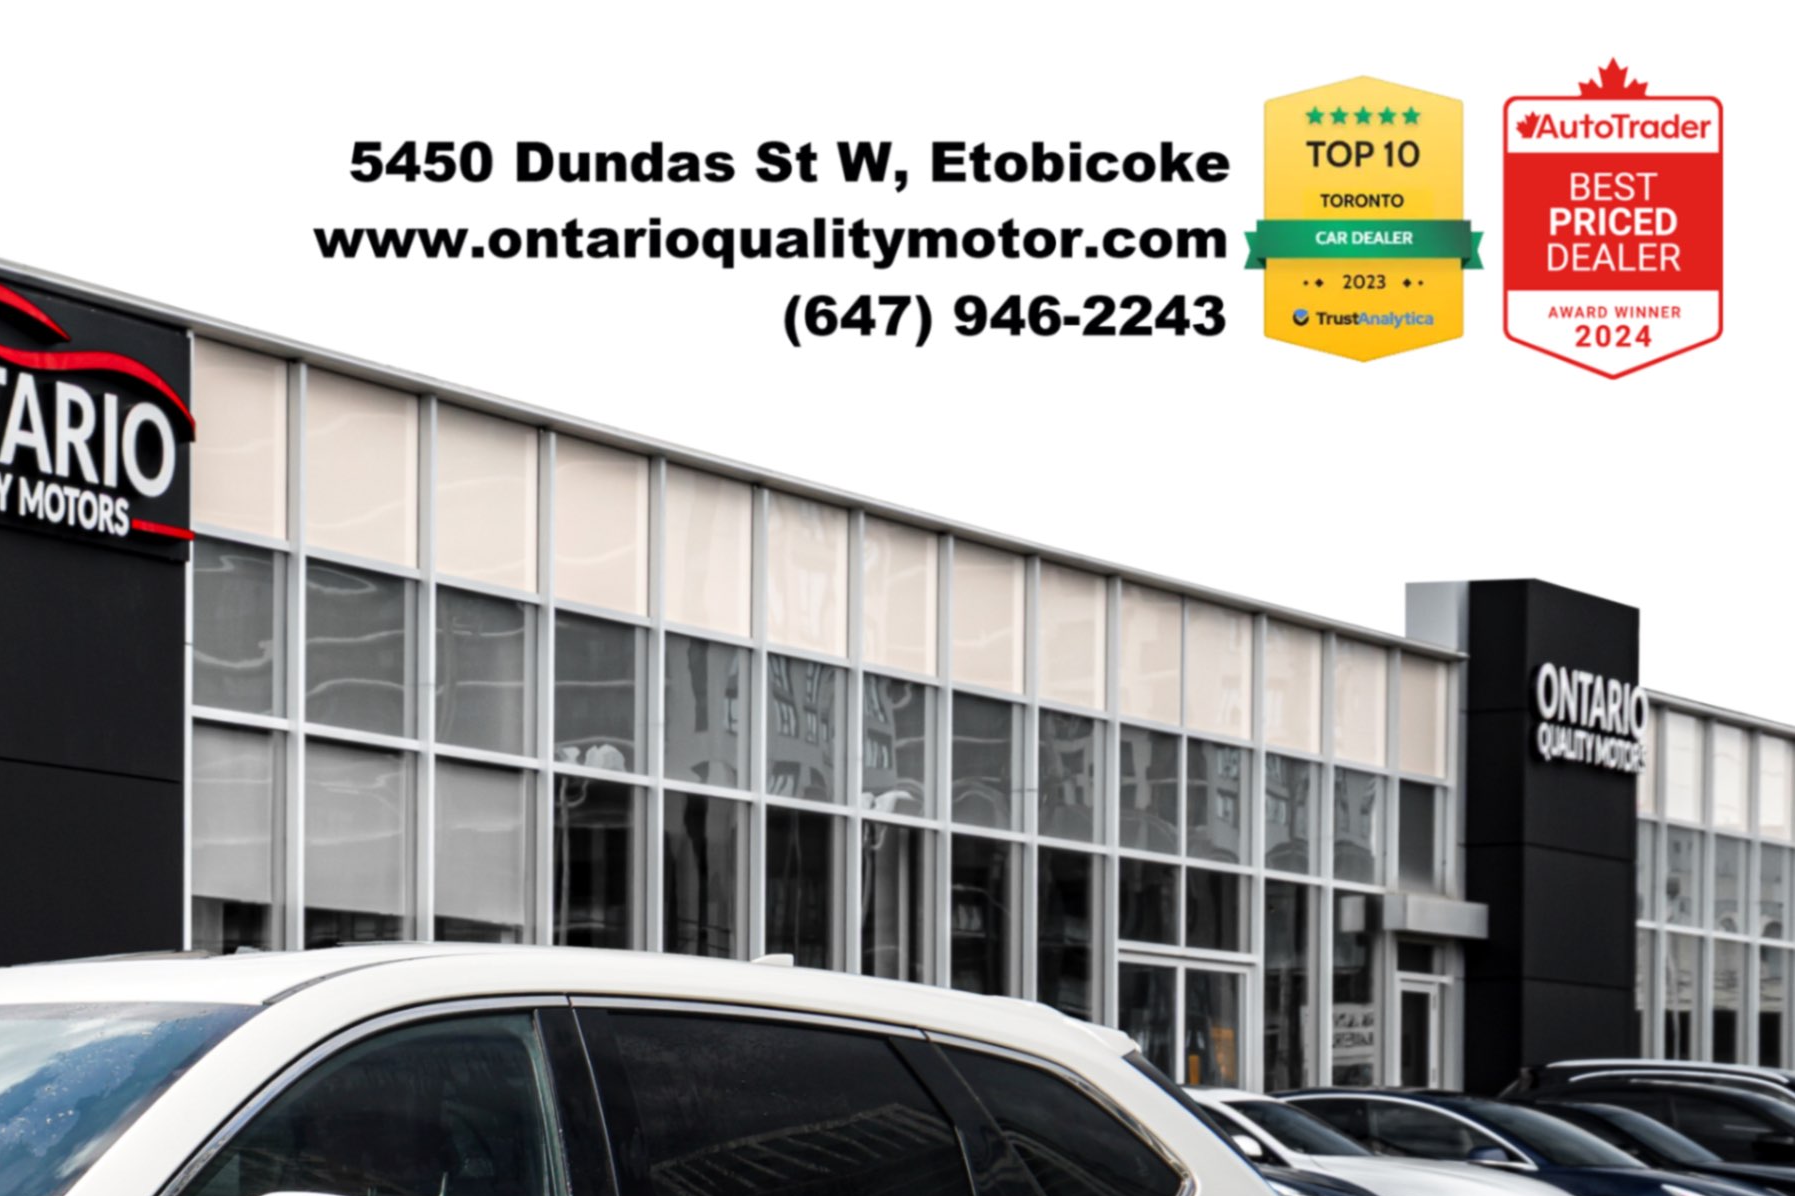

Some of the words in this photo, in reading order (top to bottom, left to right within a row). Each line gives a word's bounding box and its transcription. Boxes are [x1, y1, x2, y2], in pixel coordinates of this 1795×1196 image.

[18, 475, 131, 538] MOTORS
[1536, 661, 1650, 742] ONTARIO
[1536, 721, 1596, 764] QUALITY
